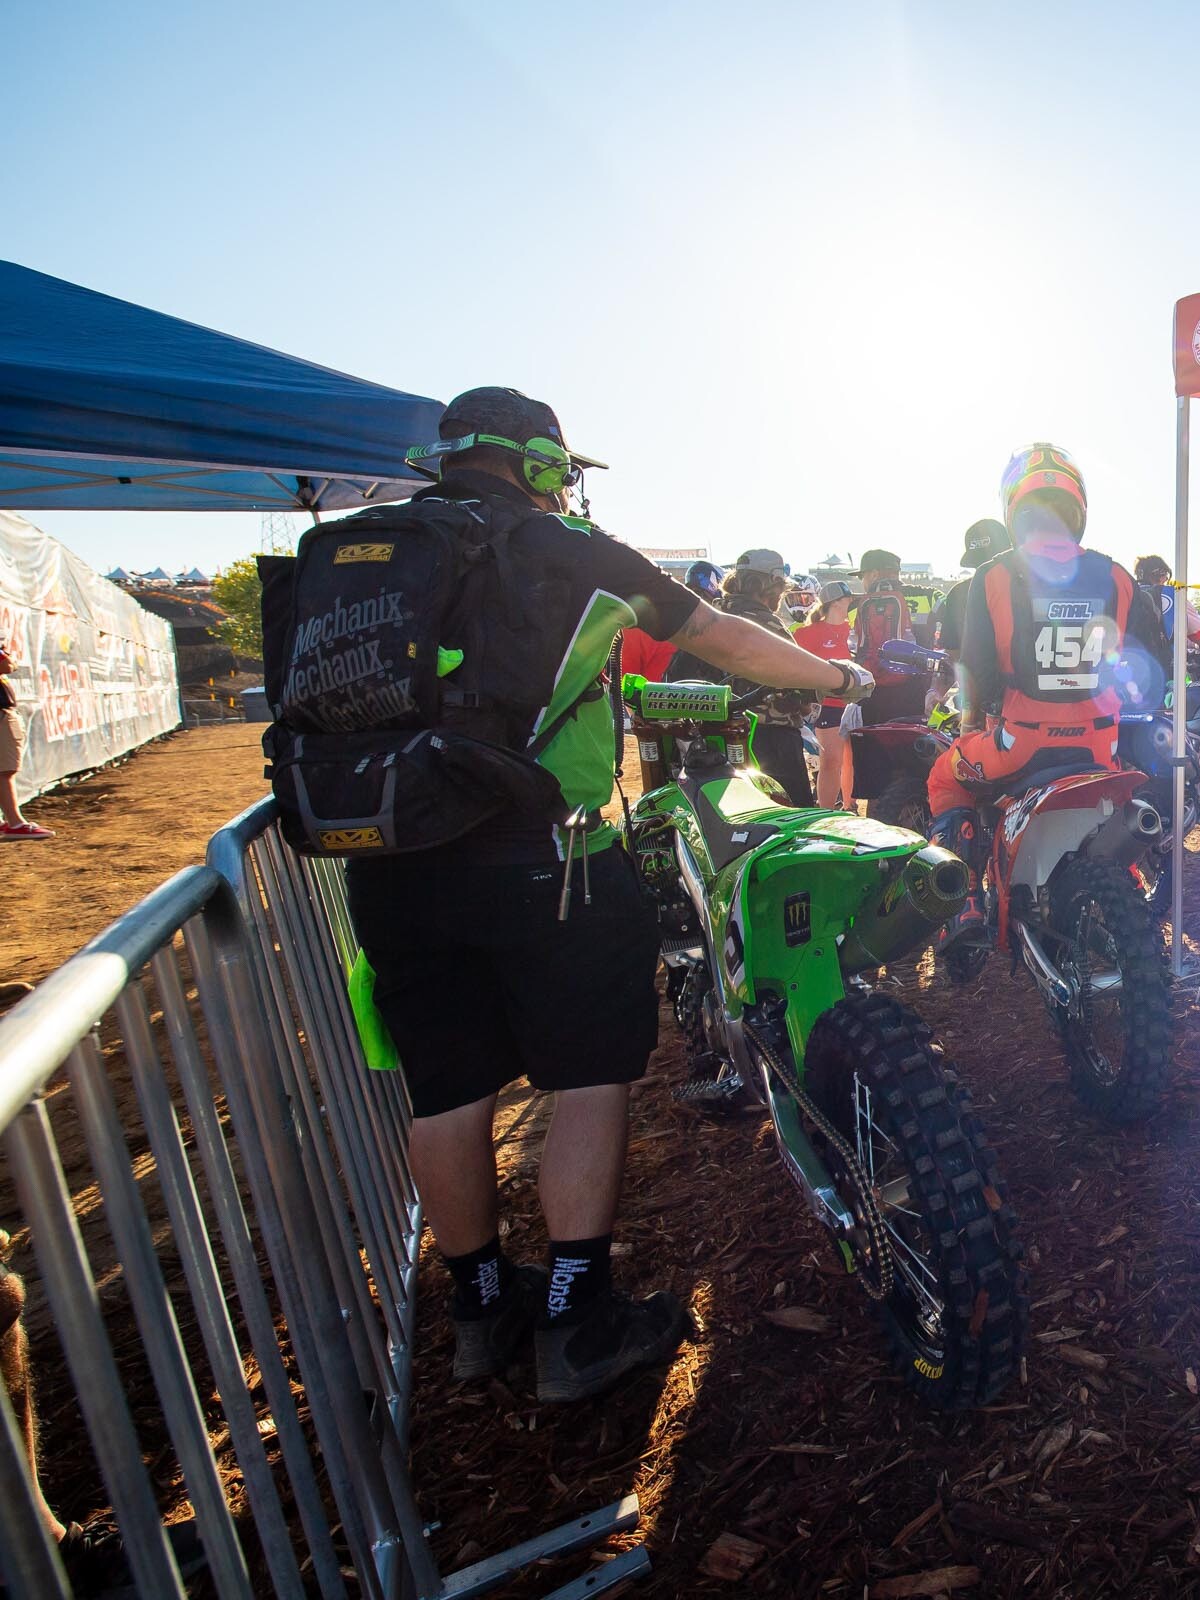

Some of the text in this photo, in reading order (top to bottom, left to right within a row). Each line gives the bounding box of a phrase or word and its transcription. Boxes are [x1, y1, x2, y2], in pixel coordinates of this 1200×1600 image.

[292, 587, 404, 660] Mechanix
[1035, 626, 1105, 669] 454
[647, 691, 719, 701] RENTHAL
[647, 701, 719, 712] RENTHAL
[1047, 727, 1086, 737] THOR
